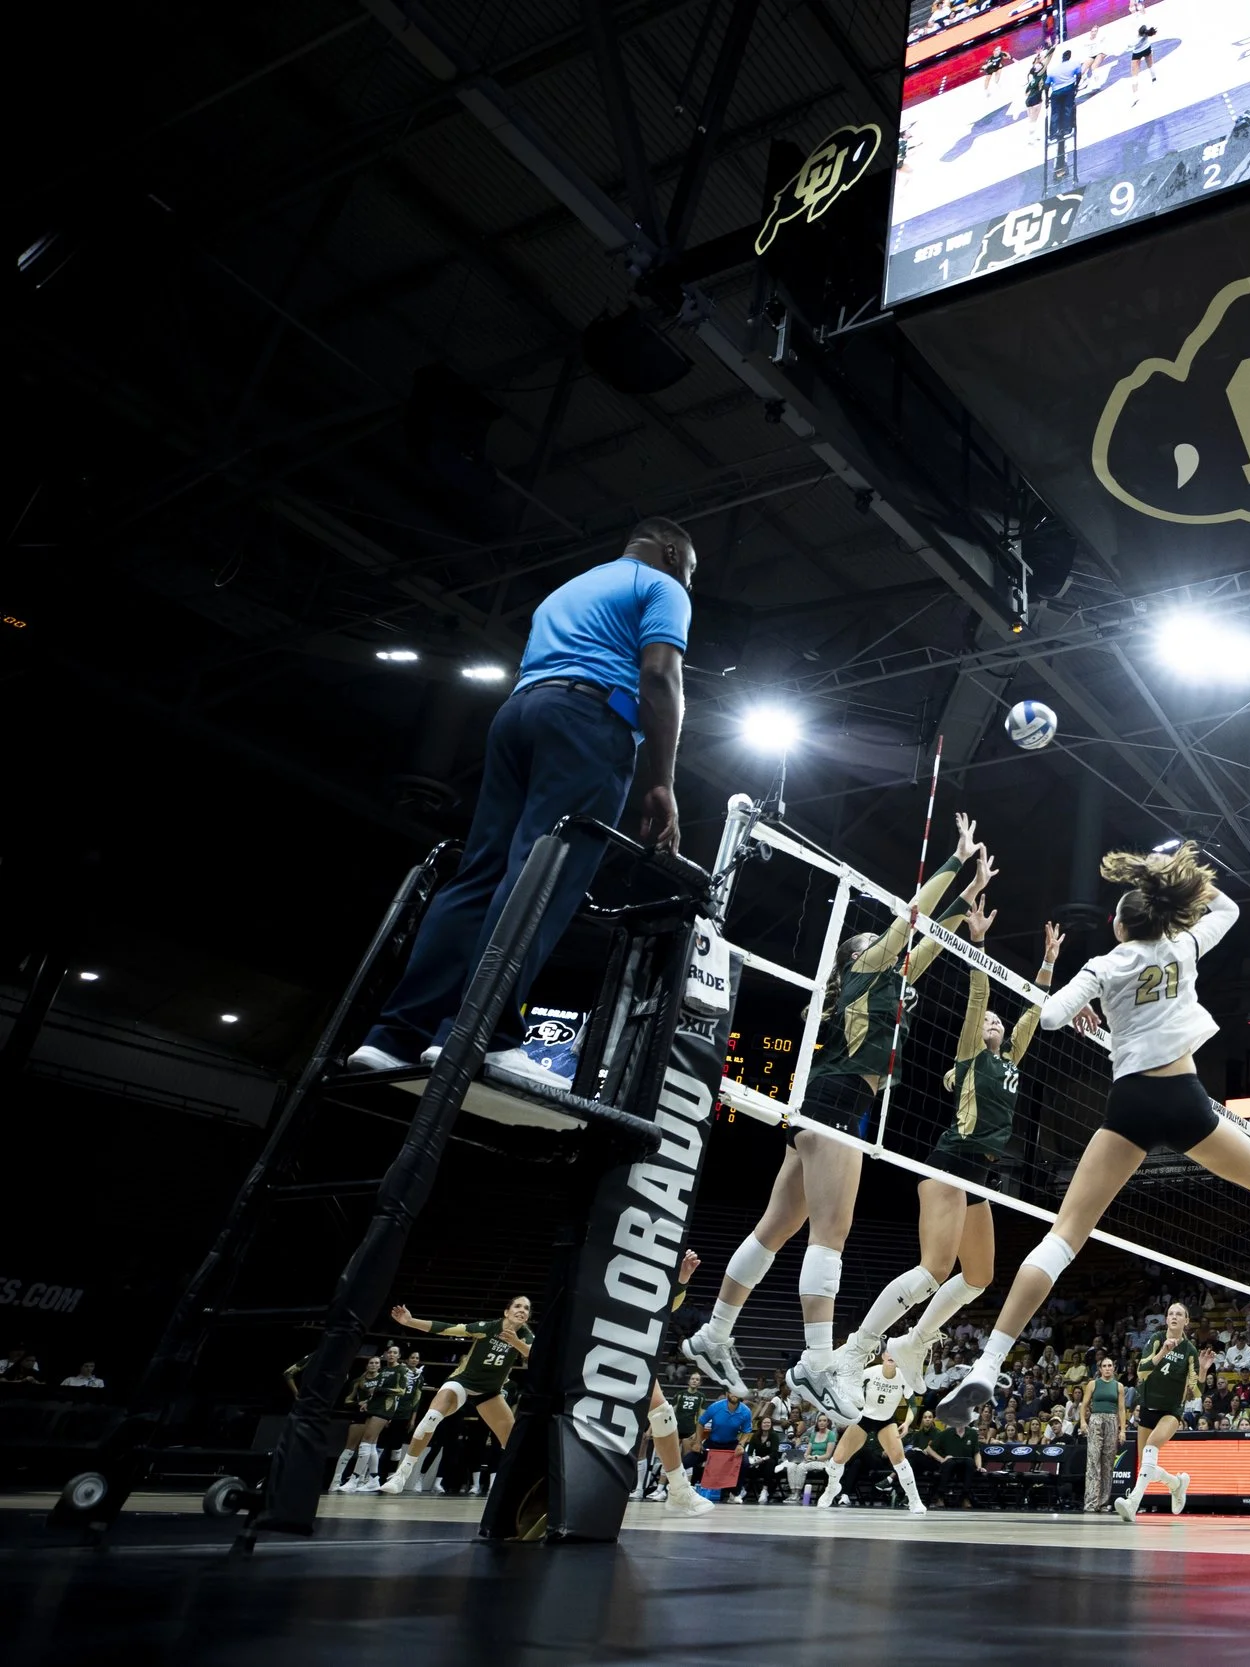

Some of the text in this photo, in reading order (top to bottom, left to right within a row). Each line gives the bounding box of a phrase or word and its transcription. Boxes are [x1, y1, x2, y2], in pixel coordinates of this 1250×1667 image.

[1202, 139, 1228, 161] SET
[1203, 164, 1222, 190] 2
[1109, 181, 1135, 218] 9
[1002, 202, 1057, 256] CU
[914, 230, 973, 264] SETS WON
[938, 259, 949, 281] 1
[930, 922, 1009, 982] COLORADO VOLLEYBALL
[1135, 961, 1179, 1006] 21
[531, 1006, 578, 1020] COLORADO
[763, 1037, 792, 1052] 5:00
[541, 1057, 553, 1071] 9
[763, 1061, 773, 1074] 2
[1003, 1070, 1019, 1094] 10
[769, 1085, 779, 1098] 2
[573, 1065, 713, 1455] COLORADO
[483, 1352, 505, 1366] 26
[1160, 1362, 1171, 1376] 4
[873, 1380, 899, 1390] COLORADO
[682, 1401, 695, 1410] 22
[877, 1394, 886, 1404] 6
[1113, 1471, 1131, 1479] TIONS
